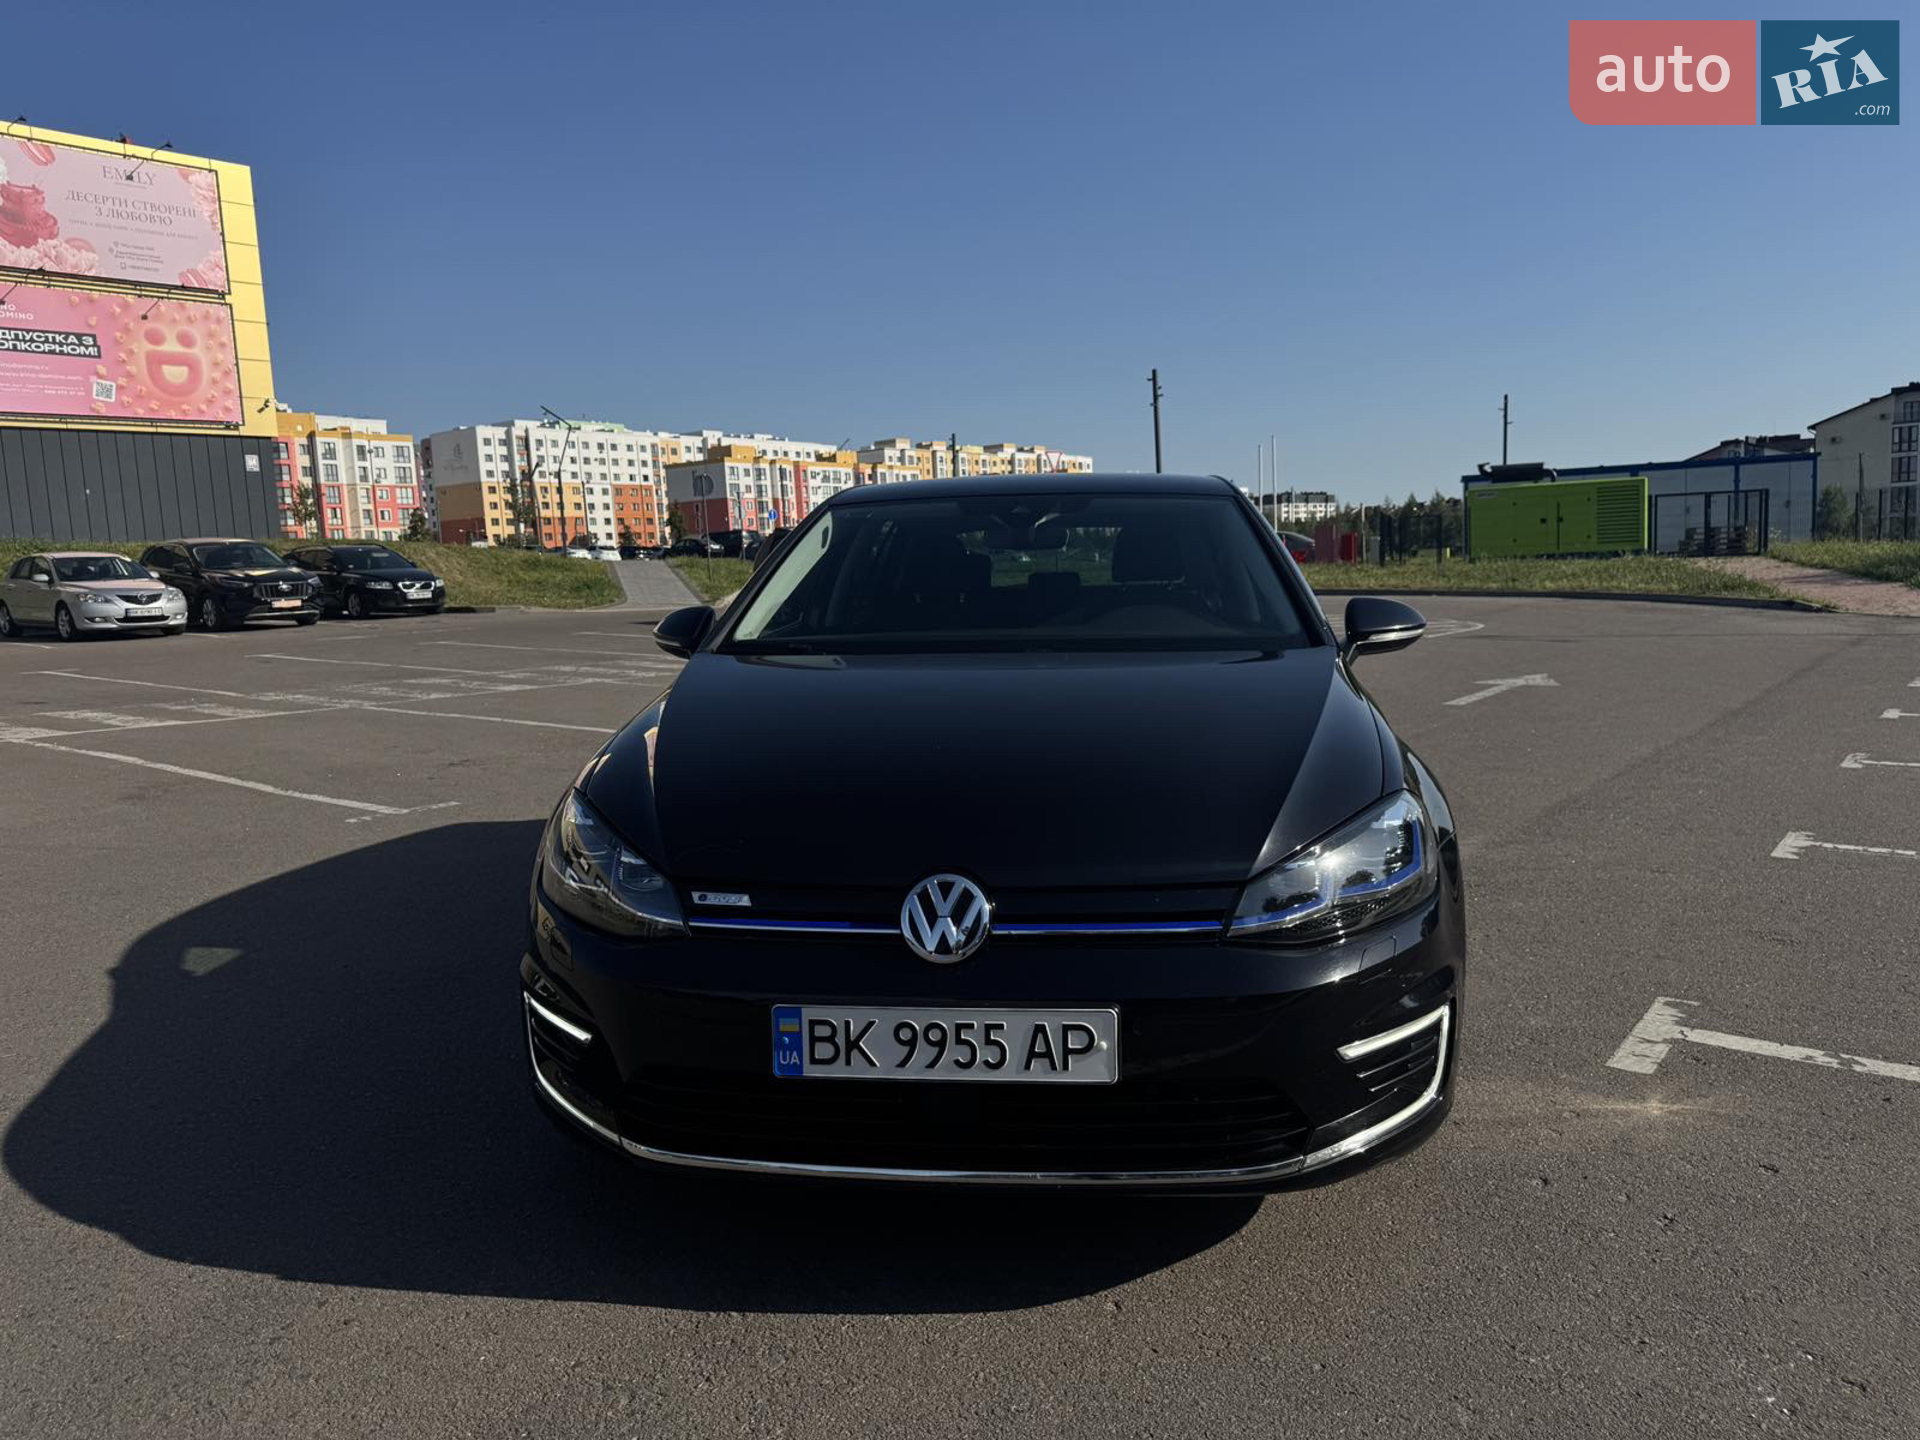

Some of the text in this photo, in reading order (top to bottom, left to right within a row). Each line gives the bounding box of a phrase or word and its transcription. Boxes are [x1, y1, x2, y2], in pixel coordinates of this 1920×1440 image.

[102, 166, 156, 186] EMLY
[65, 189, 197, 219] ДЕСЕРТИ СТВОРЕНІ
[82, 336, 94, 345] З
[807, 1018, 1098, 1072] BK 9955 AP
[779, 1049, 800, 1065] UA
